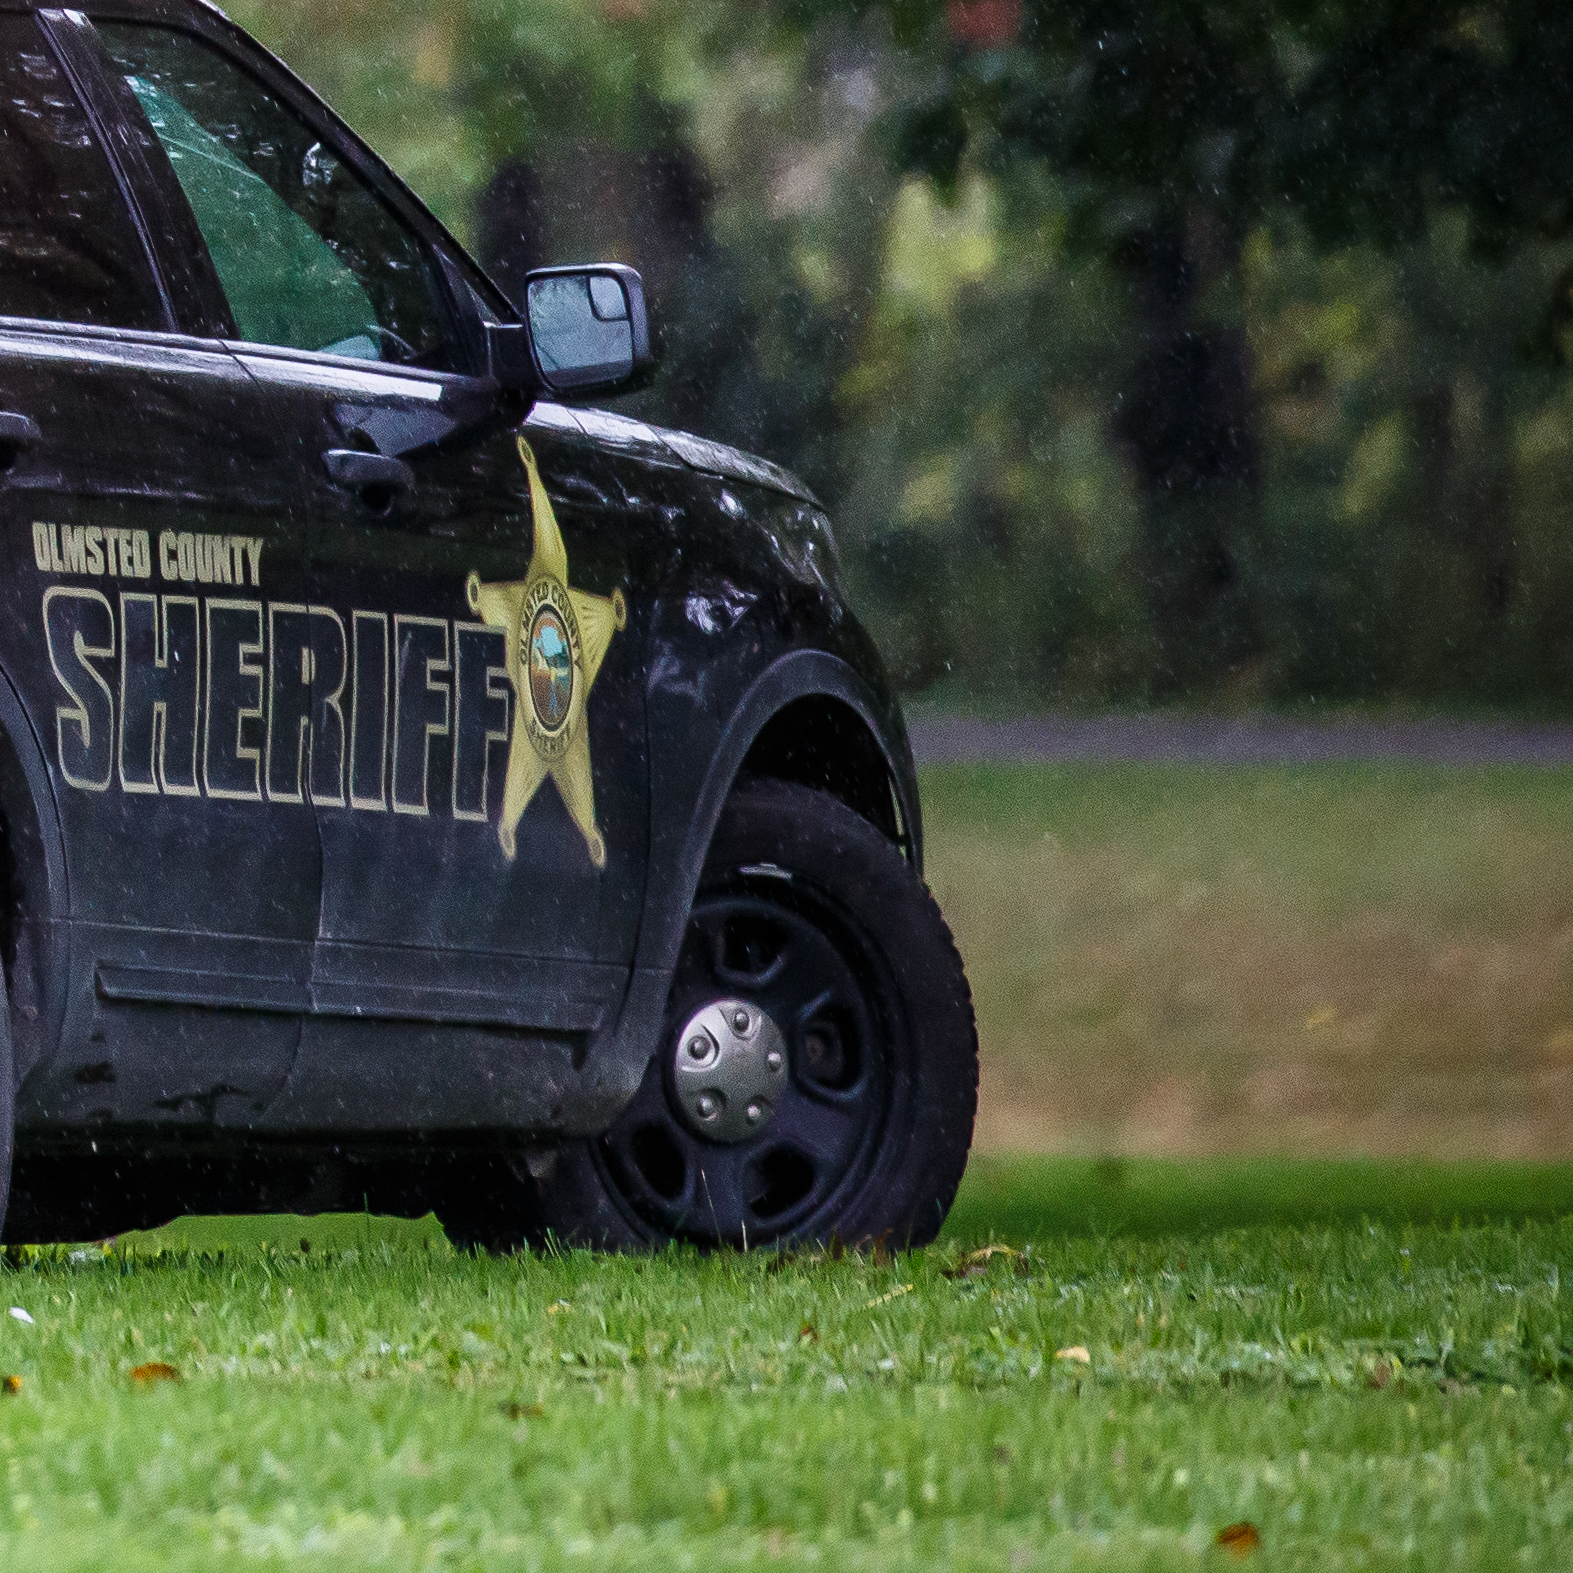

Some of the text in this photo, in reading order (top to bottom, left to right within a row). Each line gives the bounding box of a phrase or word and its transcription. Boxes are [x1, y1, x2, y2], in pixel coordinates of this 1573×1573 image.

[31, 521, 264, 587] OLMSTED COUNTY
[42, 586, 512, 823] SHERIFF
